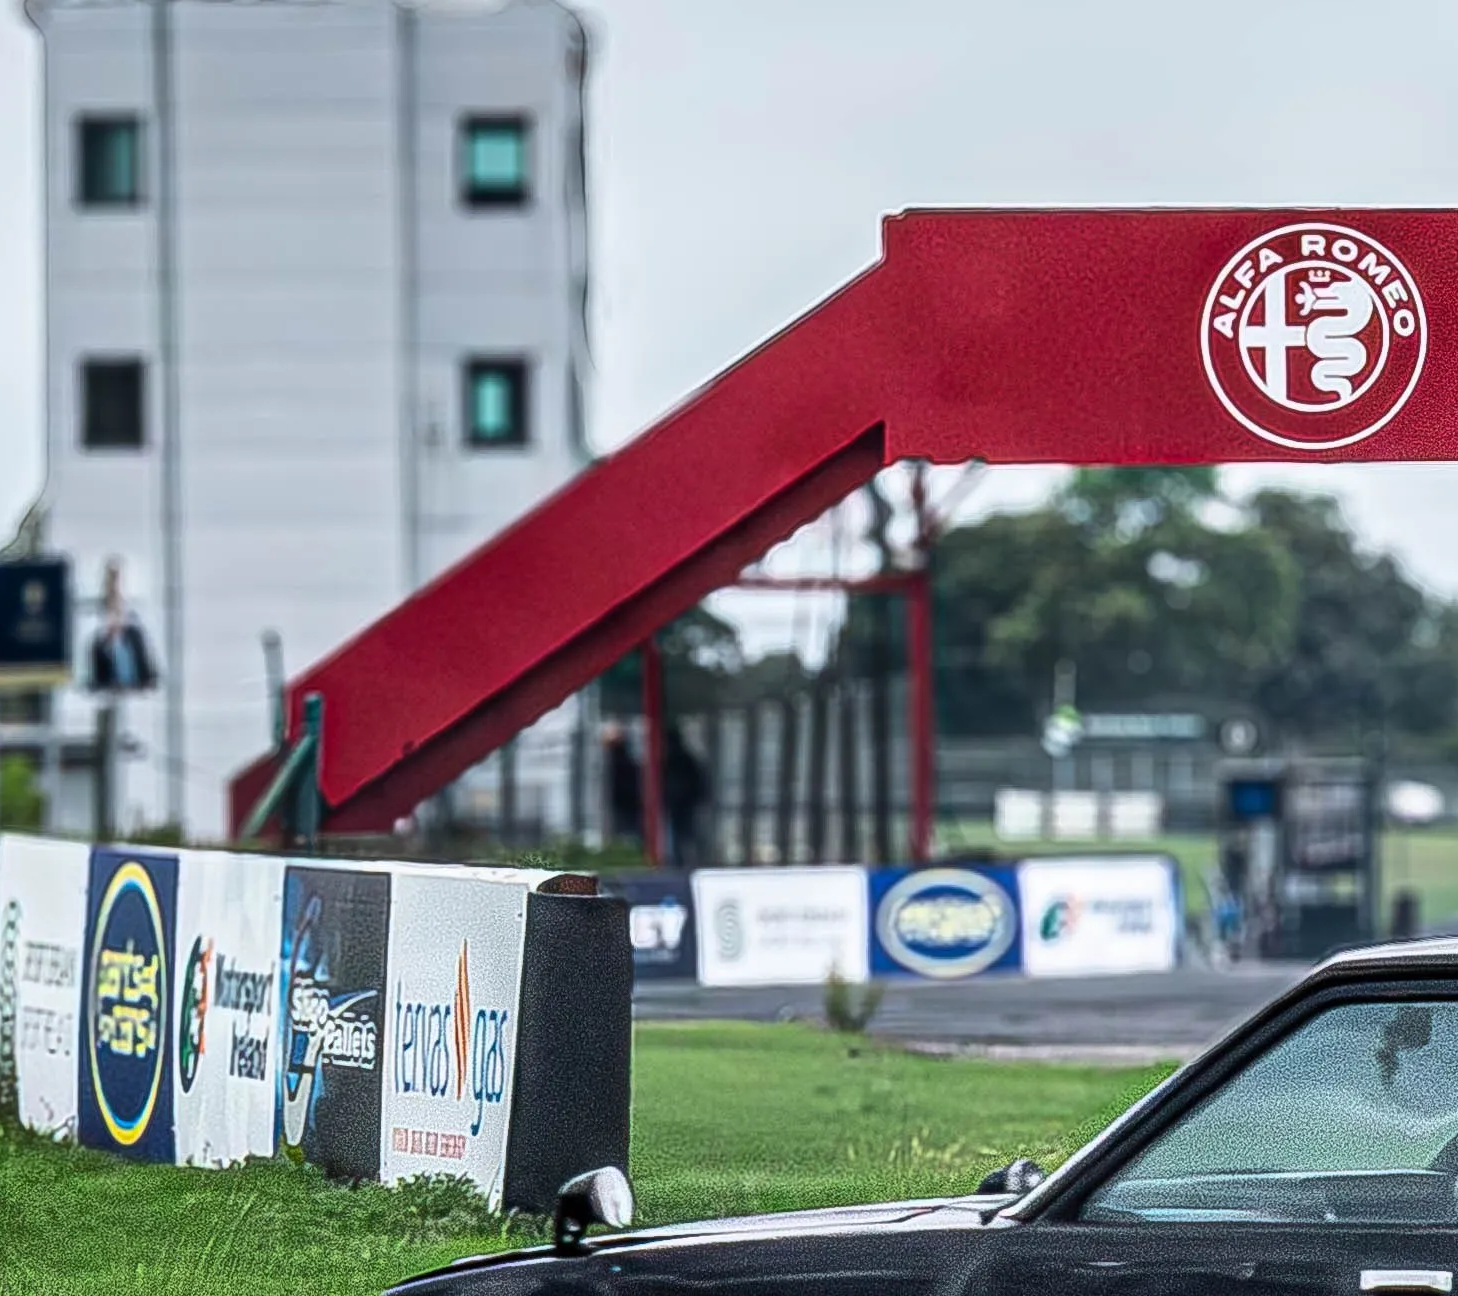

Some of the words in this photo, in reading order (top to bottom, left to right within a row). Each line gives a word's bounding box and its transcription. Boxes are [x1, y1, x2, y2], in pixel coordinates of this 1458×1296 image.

[1213, 247, 1284, 339] ALFA
[1300, 234, 1416, 338] ROMEO
[470, 1007, 509, 1138] gas
